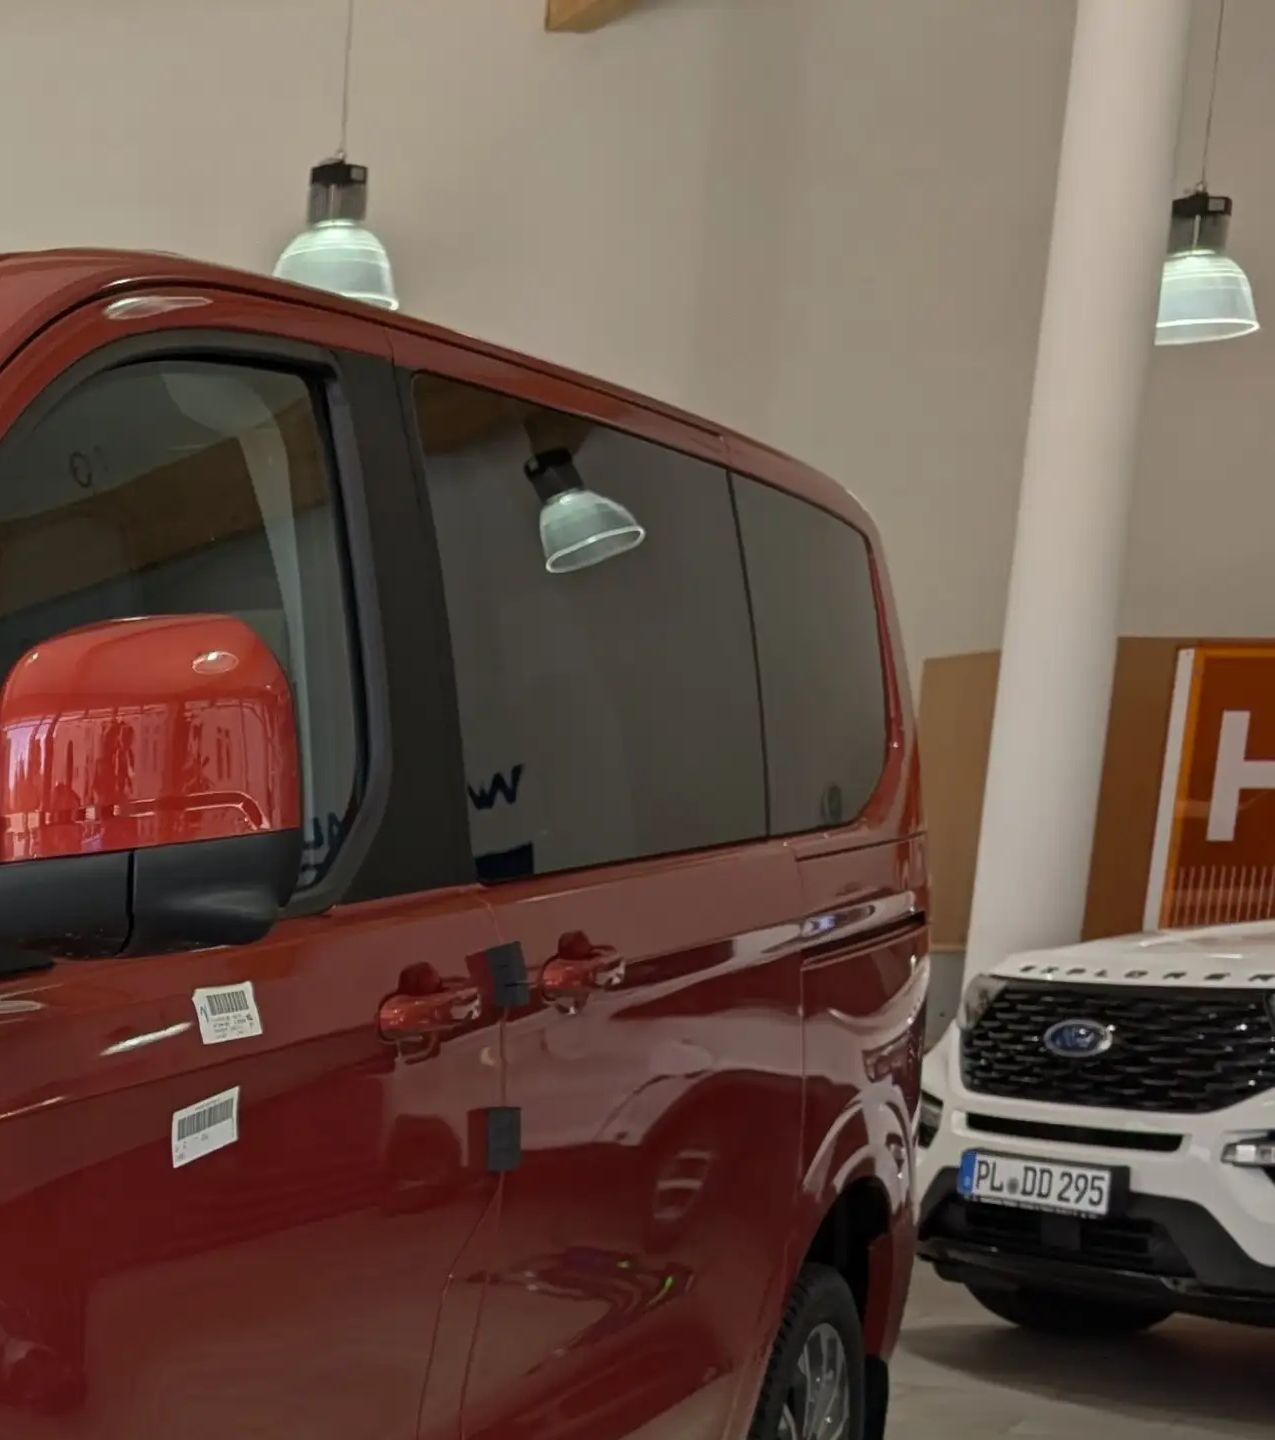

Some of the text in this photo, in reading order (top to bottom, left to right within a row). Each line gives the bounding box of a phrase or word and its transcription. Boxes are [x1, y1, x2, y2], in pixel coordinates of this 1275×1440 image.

[976, 1160, 1105, 1206] PL DD 295
